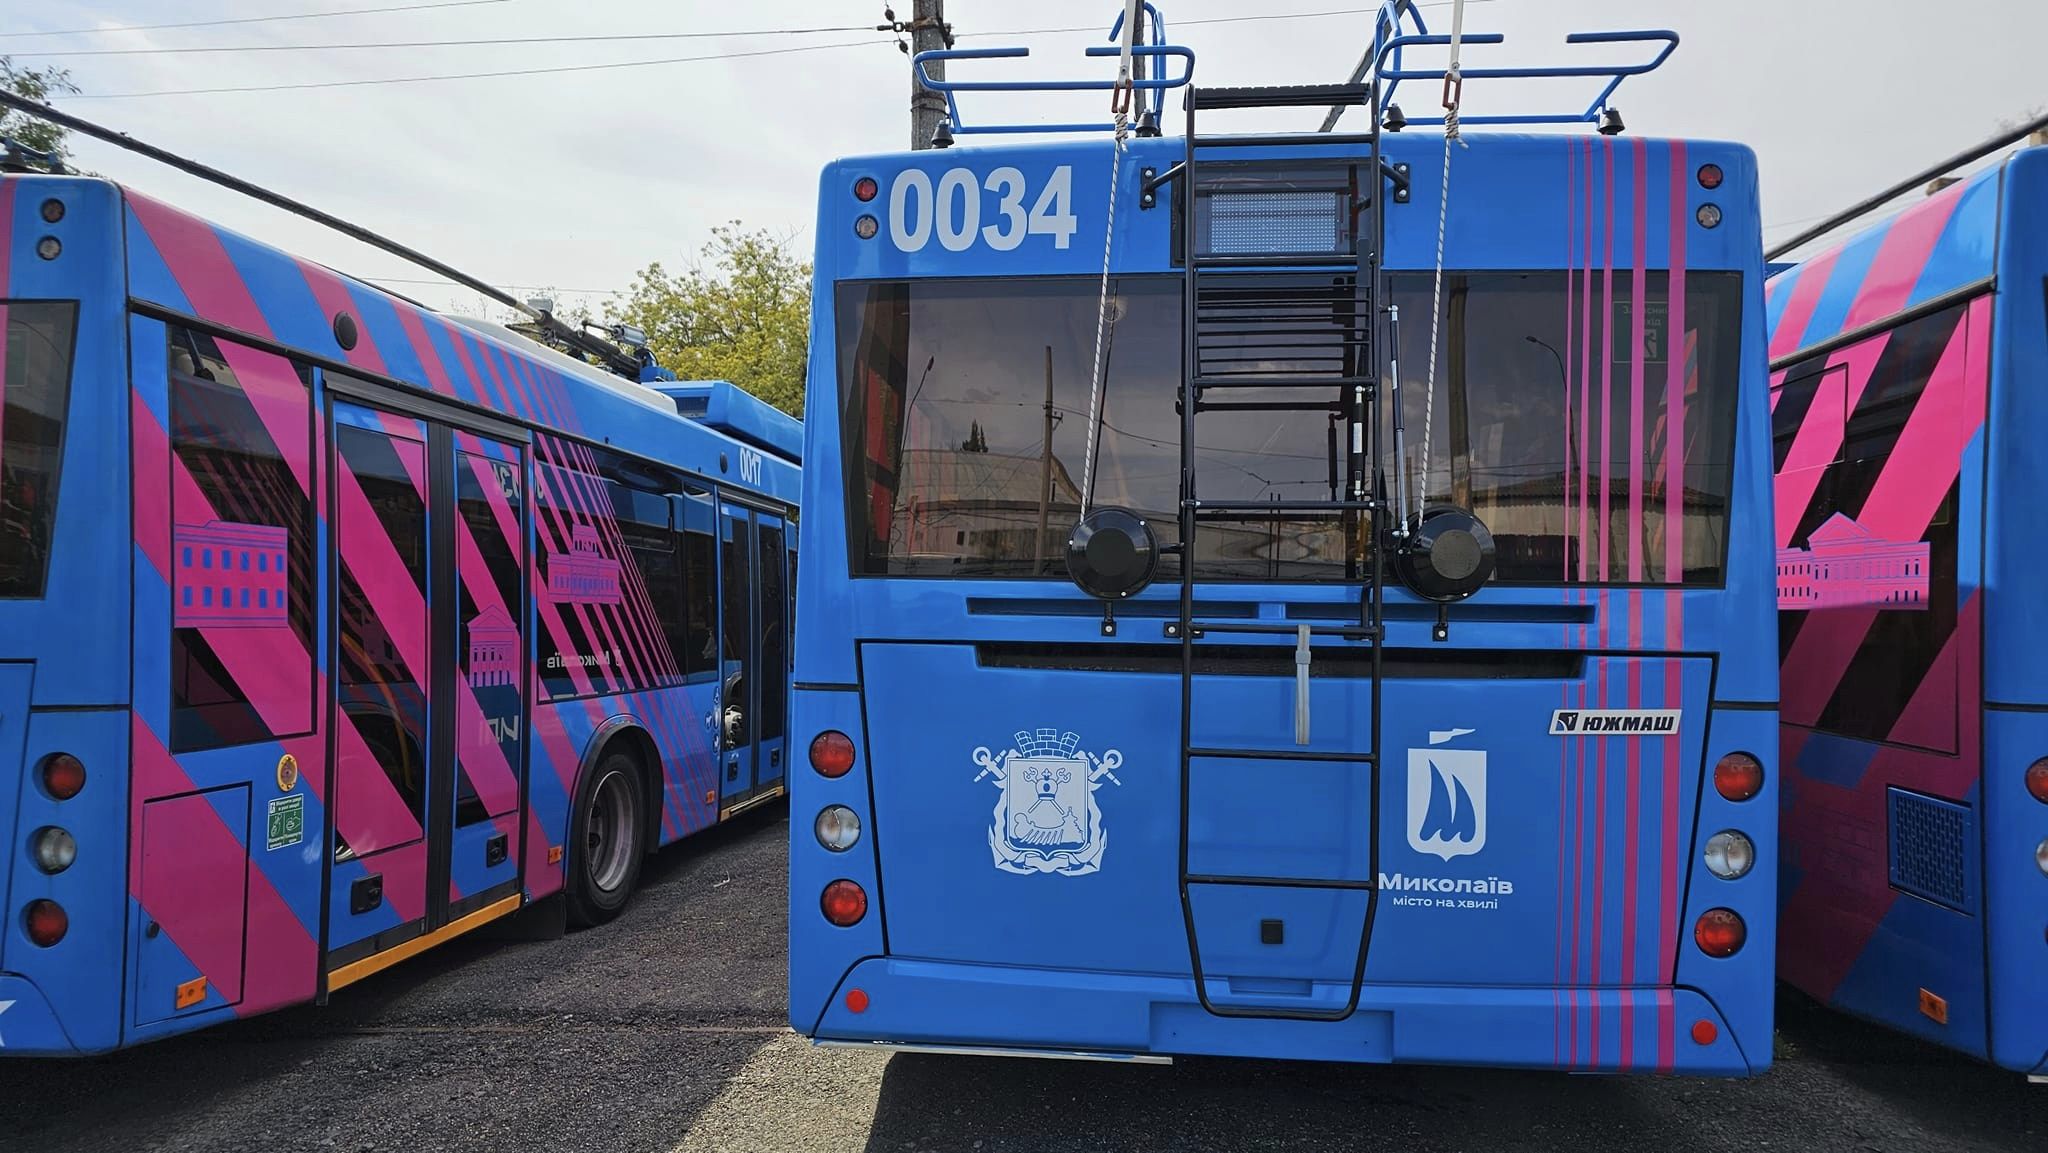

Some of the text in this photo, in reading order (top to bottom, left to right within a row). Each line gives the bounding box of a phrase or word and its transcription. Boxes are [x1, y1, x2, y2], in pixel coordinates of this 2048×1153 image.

[889, 165, 1077, 252] 0034
[740, 447, 762, 487] 0017
[1582, 716, 1674, 731] ЮЖМАШ
[1378, 872, 1513, 894] Миколаїв
[1393, 896, 1498, 909] місто на хвилі
